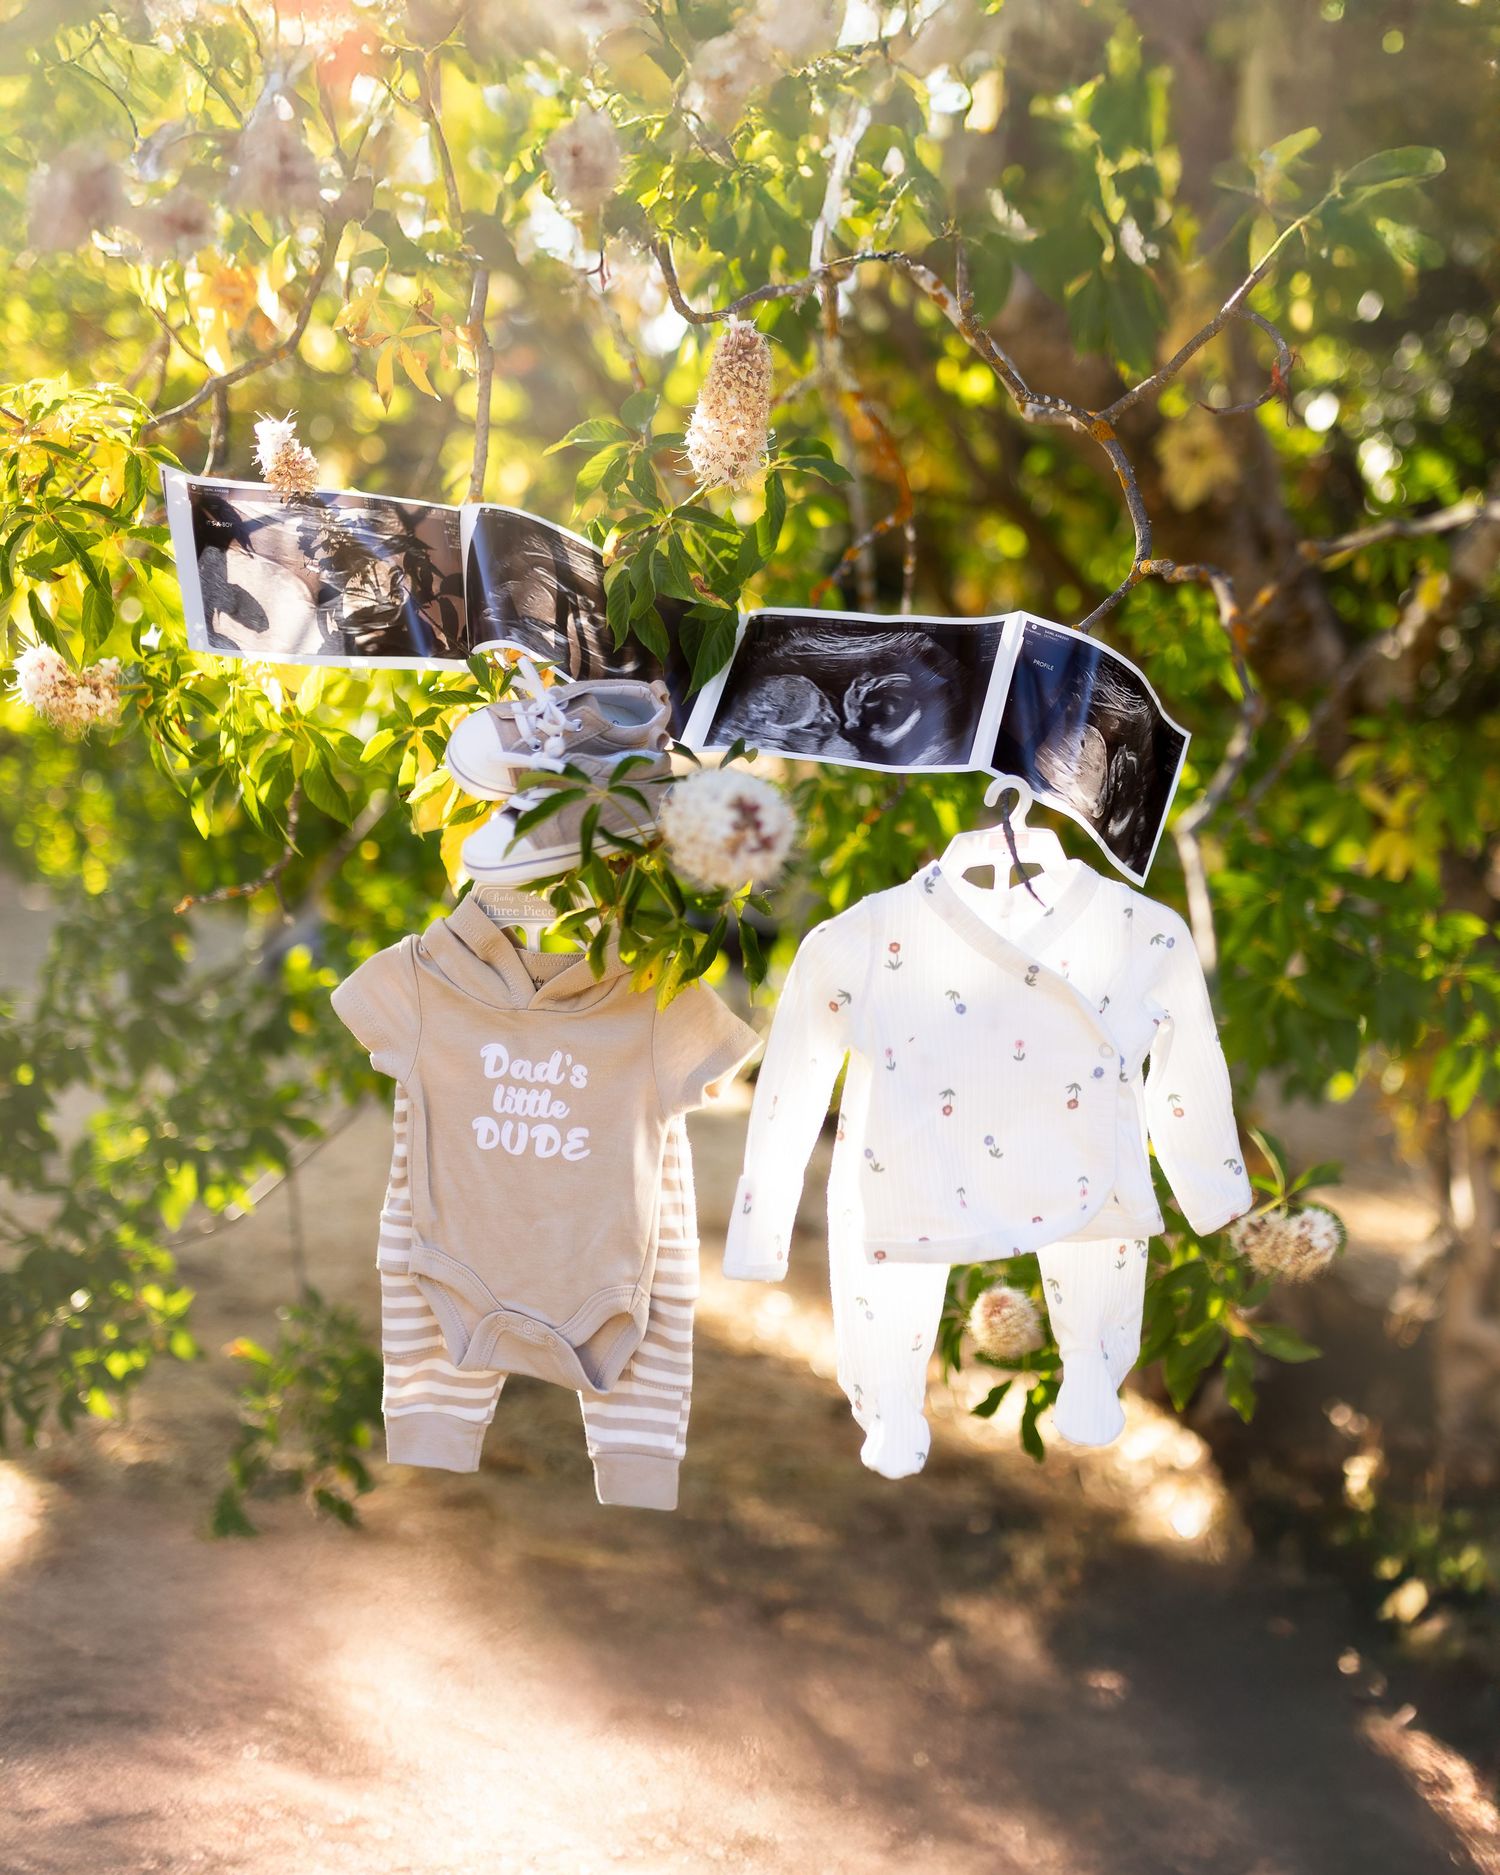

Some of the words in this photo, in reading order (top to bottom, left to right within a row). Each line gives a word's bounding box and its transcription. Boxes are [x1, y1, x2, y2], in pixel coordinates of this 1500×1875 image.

[1033, 658, 1055, 671] PROFILE
[483, 904, 520, 917] Three
[523, 904, 554, 917] Piece
[480, 1043, 588, 1088] Dad's
[493, 1083, 570, 1119] little
[472, 1116, 591, 1161] DUDE
